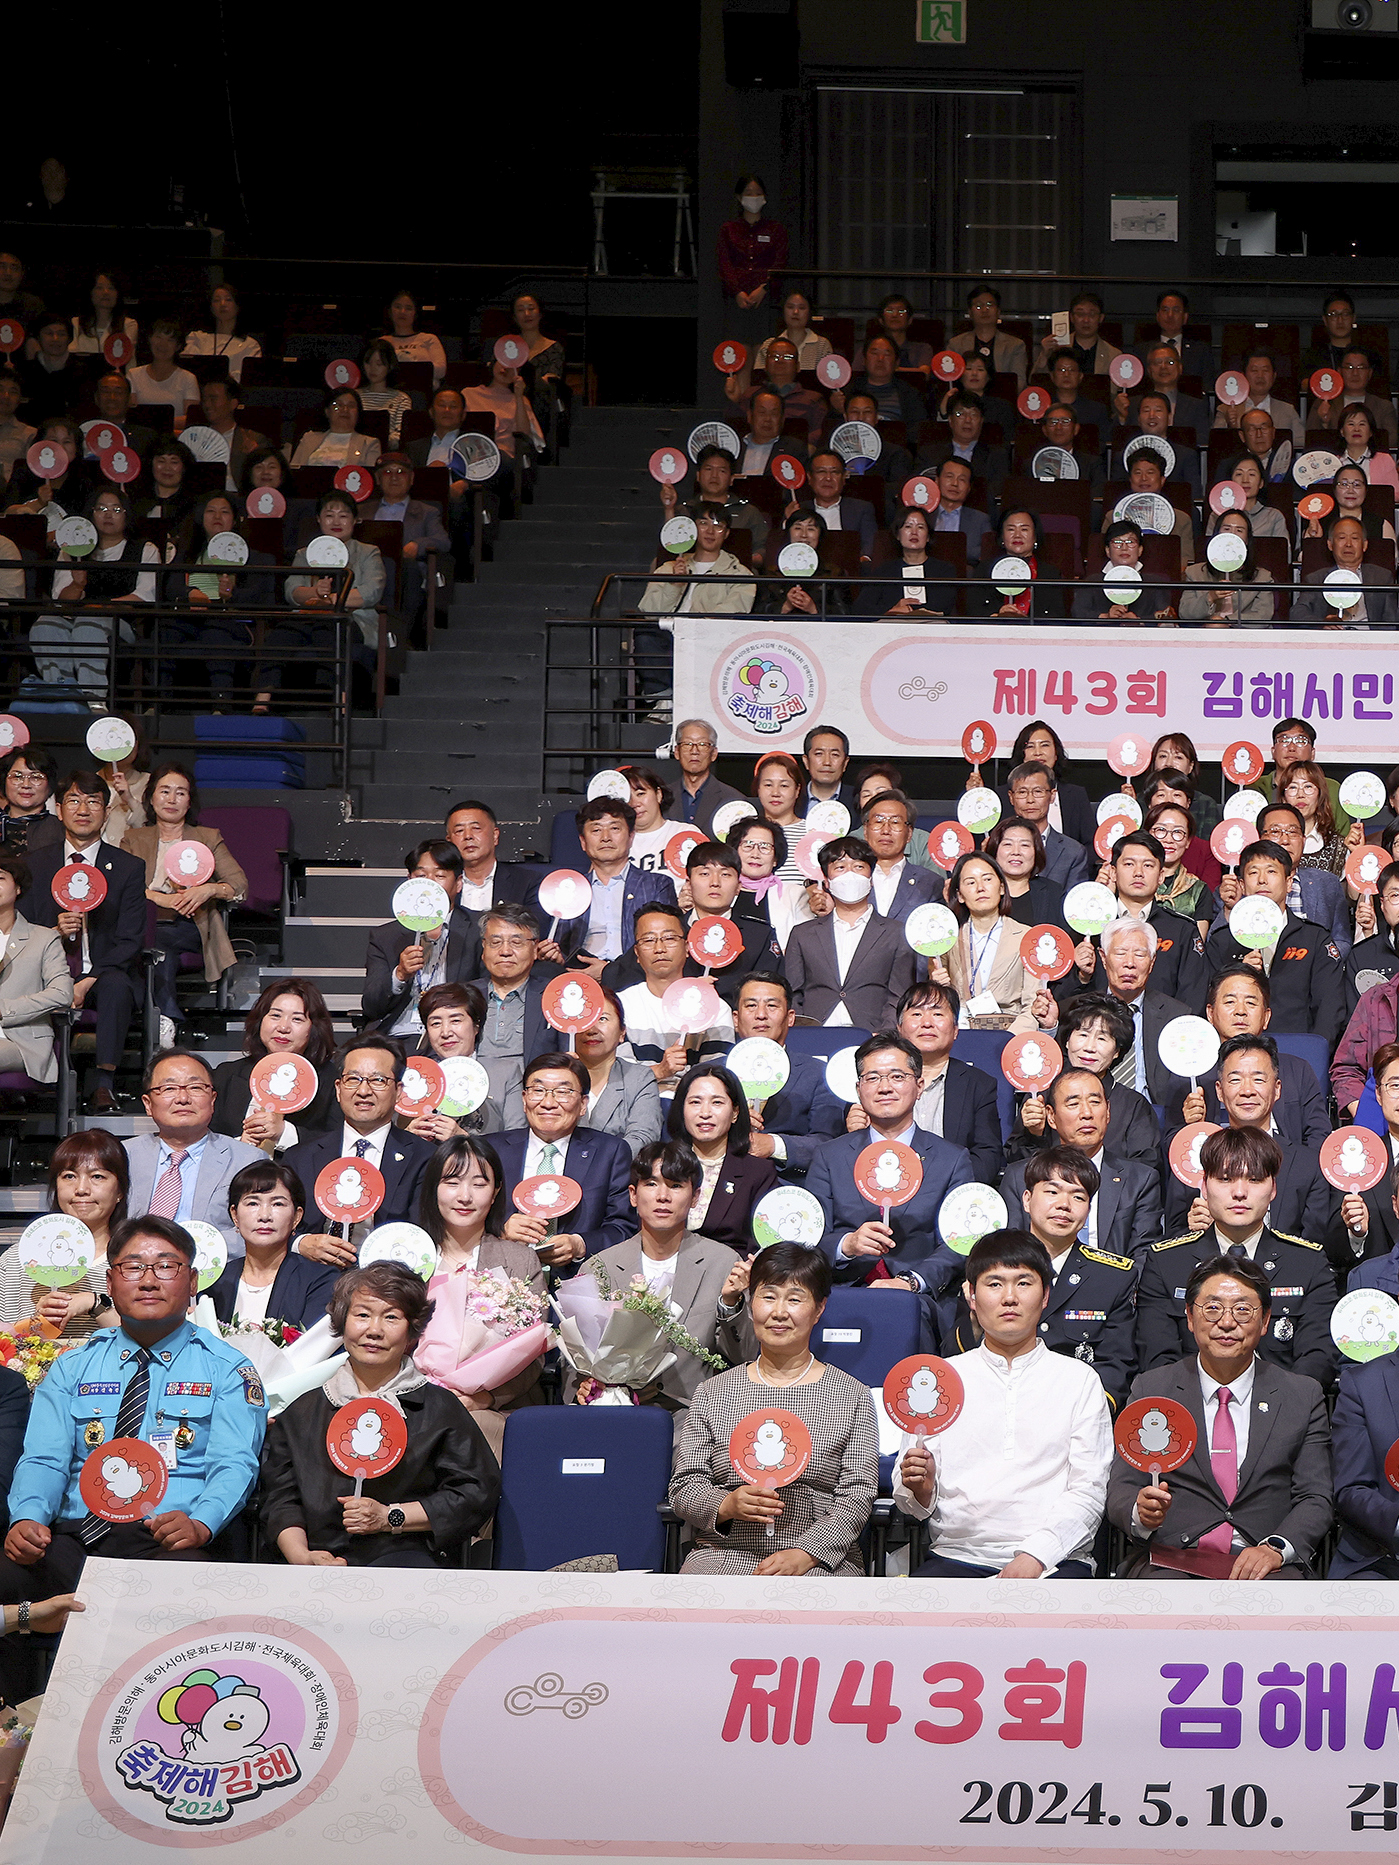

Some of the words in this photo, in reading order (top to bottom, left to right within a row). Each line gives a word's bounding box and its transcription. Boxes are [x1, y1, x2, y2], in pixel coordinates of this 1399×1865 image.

[993, 669, 1167, 717] 제43회
[757, 721, 778, 729] 2024
[723, 1658, 1087, 1749] 제43회
[173, 1798, 225, 1816] 2024
[961, 1782, 1121, 1827] 2024.
[1140, 1784, 1189, 1827] 5.
[1208, 1786, 1284, 1829] 10.
